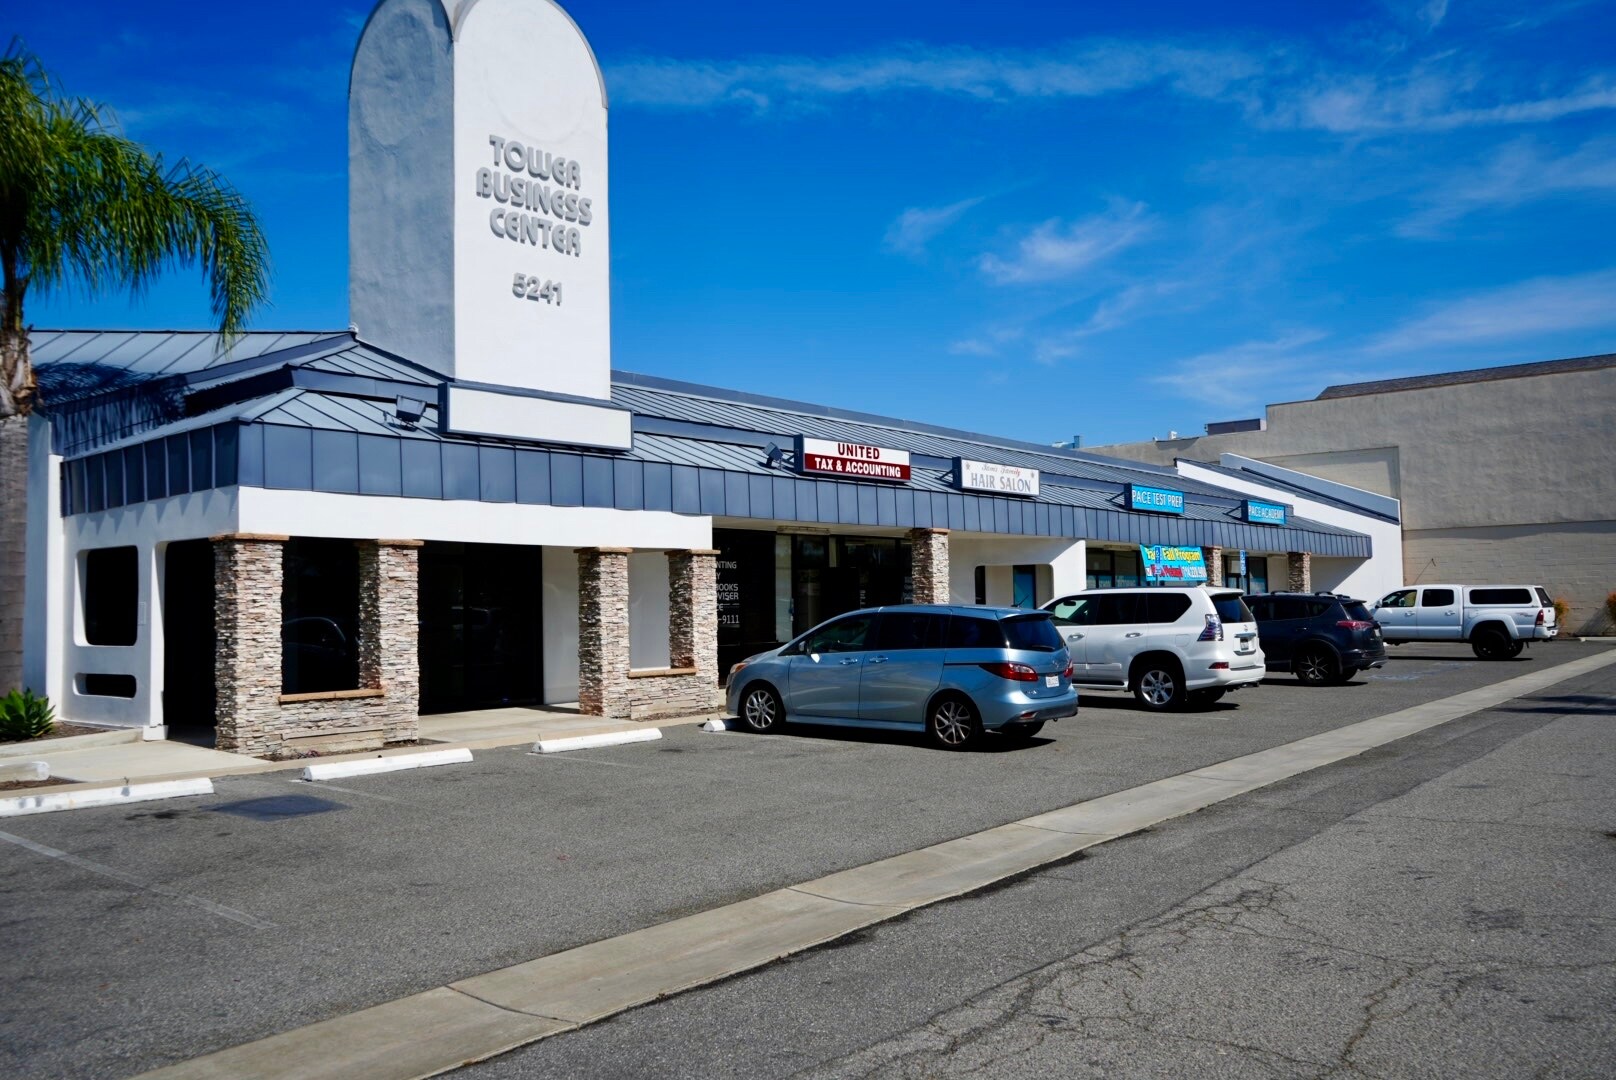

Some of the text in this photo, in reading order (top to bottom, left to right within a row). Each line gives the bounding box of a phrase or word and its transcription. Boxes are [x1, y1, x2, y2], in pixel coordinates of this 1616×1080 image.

[489, 134, 581, 190] TOWER
[476, 167, 592, 226] BUSINESS
[489, 207, 581, 257] CENTER
[512, 272, 562, 306] 5241
[837, 442, 880, 460] UNITED
[815, 457, 901, 478] TAX & ACCOUNTING
[971, 472, 1031, 493] HAIR SALON
[1132, 489, 1183, 508] PACE TEST PREP
[716, 561, 737, 569] NTING
[718, 614, 740, 625] -9111
